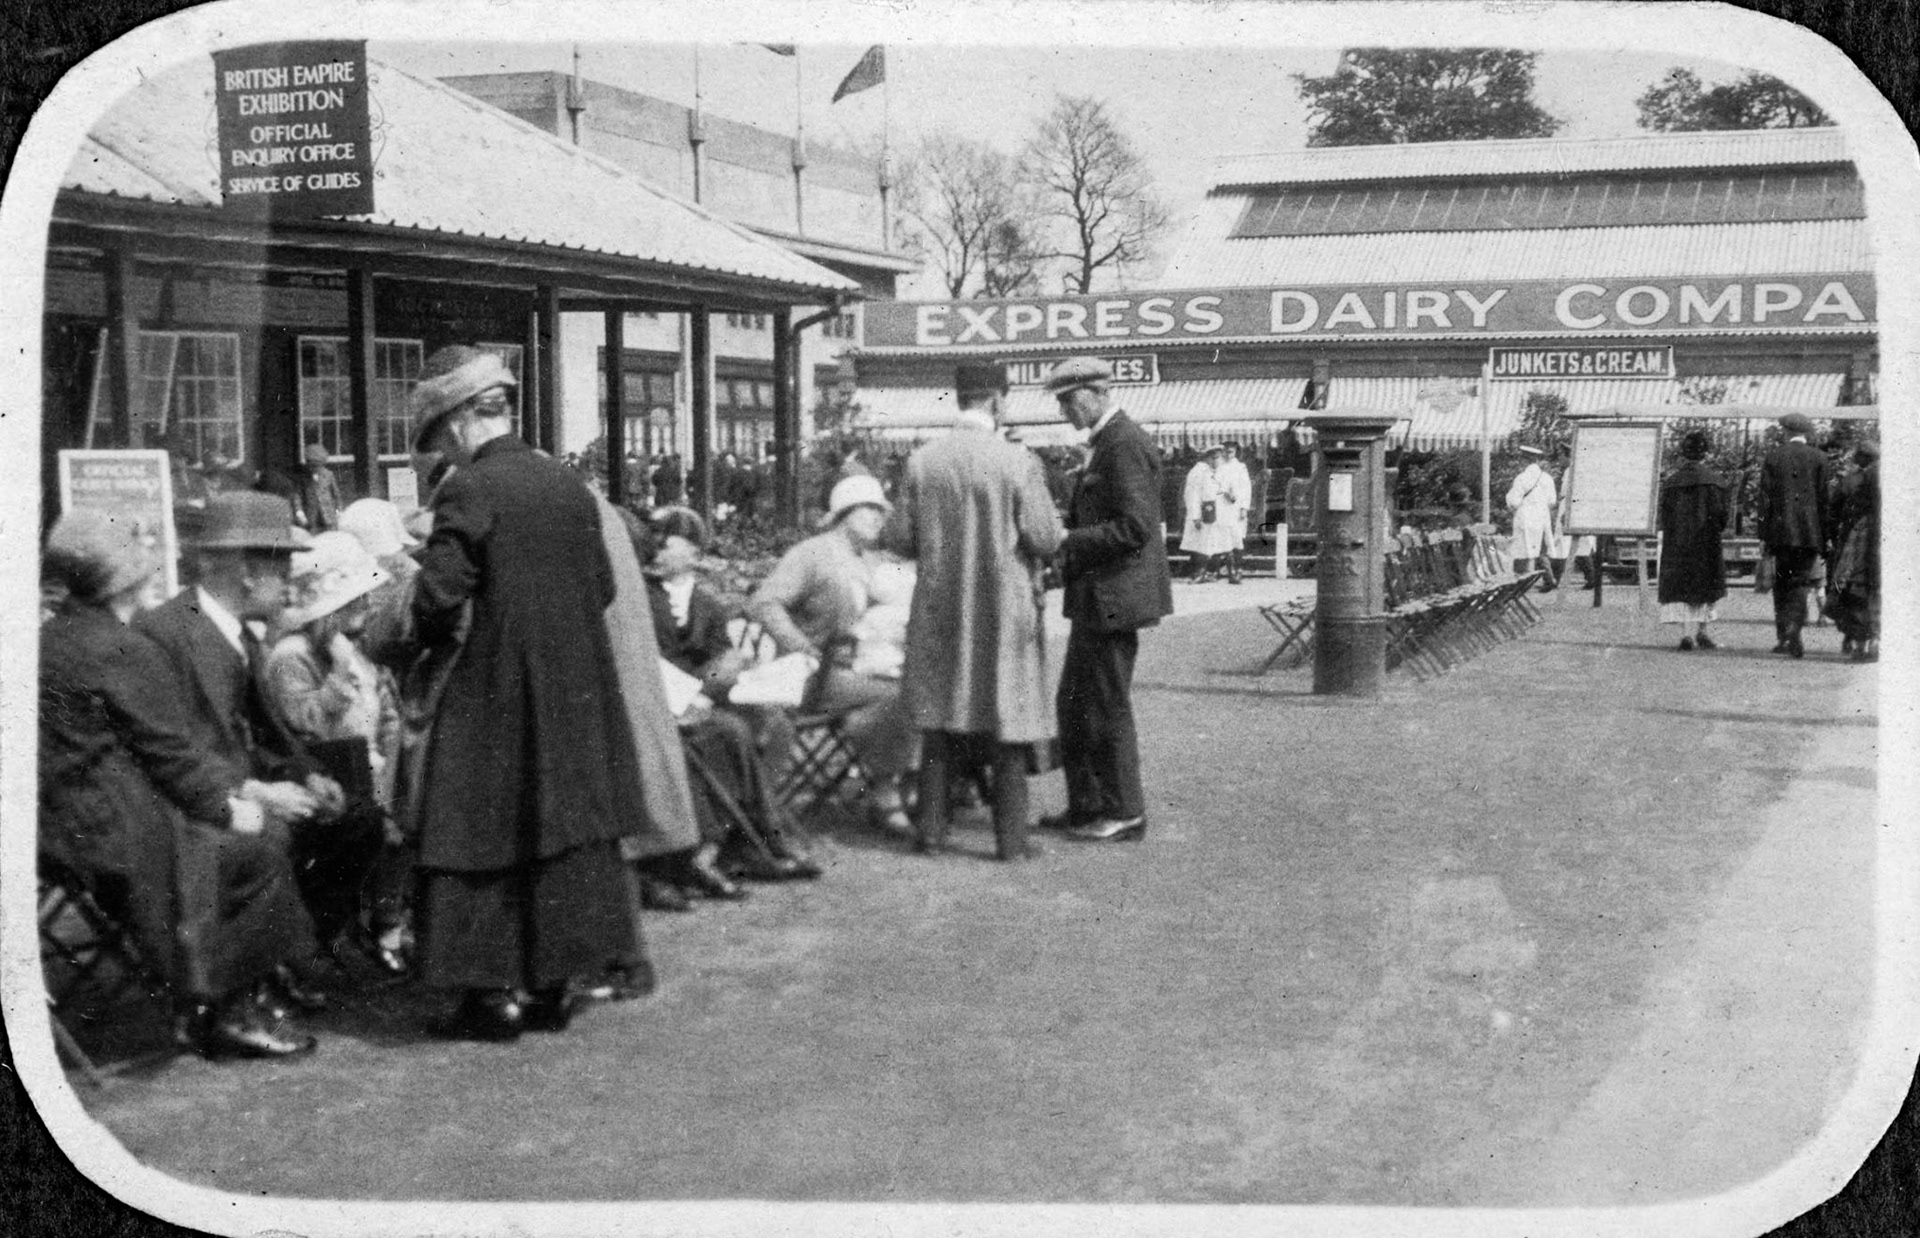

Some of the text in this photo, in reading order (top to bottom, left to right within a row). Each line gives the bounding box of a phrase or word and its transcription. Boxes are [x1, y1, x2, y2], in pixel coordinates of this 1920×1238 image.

[224, 61, 355, 91] BRITISH EMPIRE
[238, 88, 344, 116] EXHIBITION
[251, 122, 332, 144] OFFICIAL
[231, 142, 356, 167] ENQUIRY OFFICE
[230, 172, 361, 194] SERVICE OF GUIDES
[916, 282, 1866, 345] EXPRESS DAIRY COMPA
